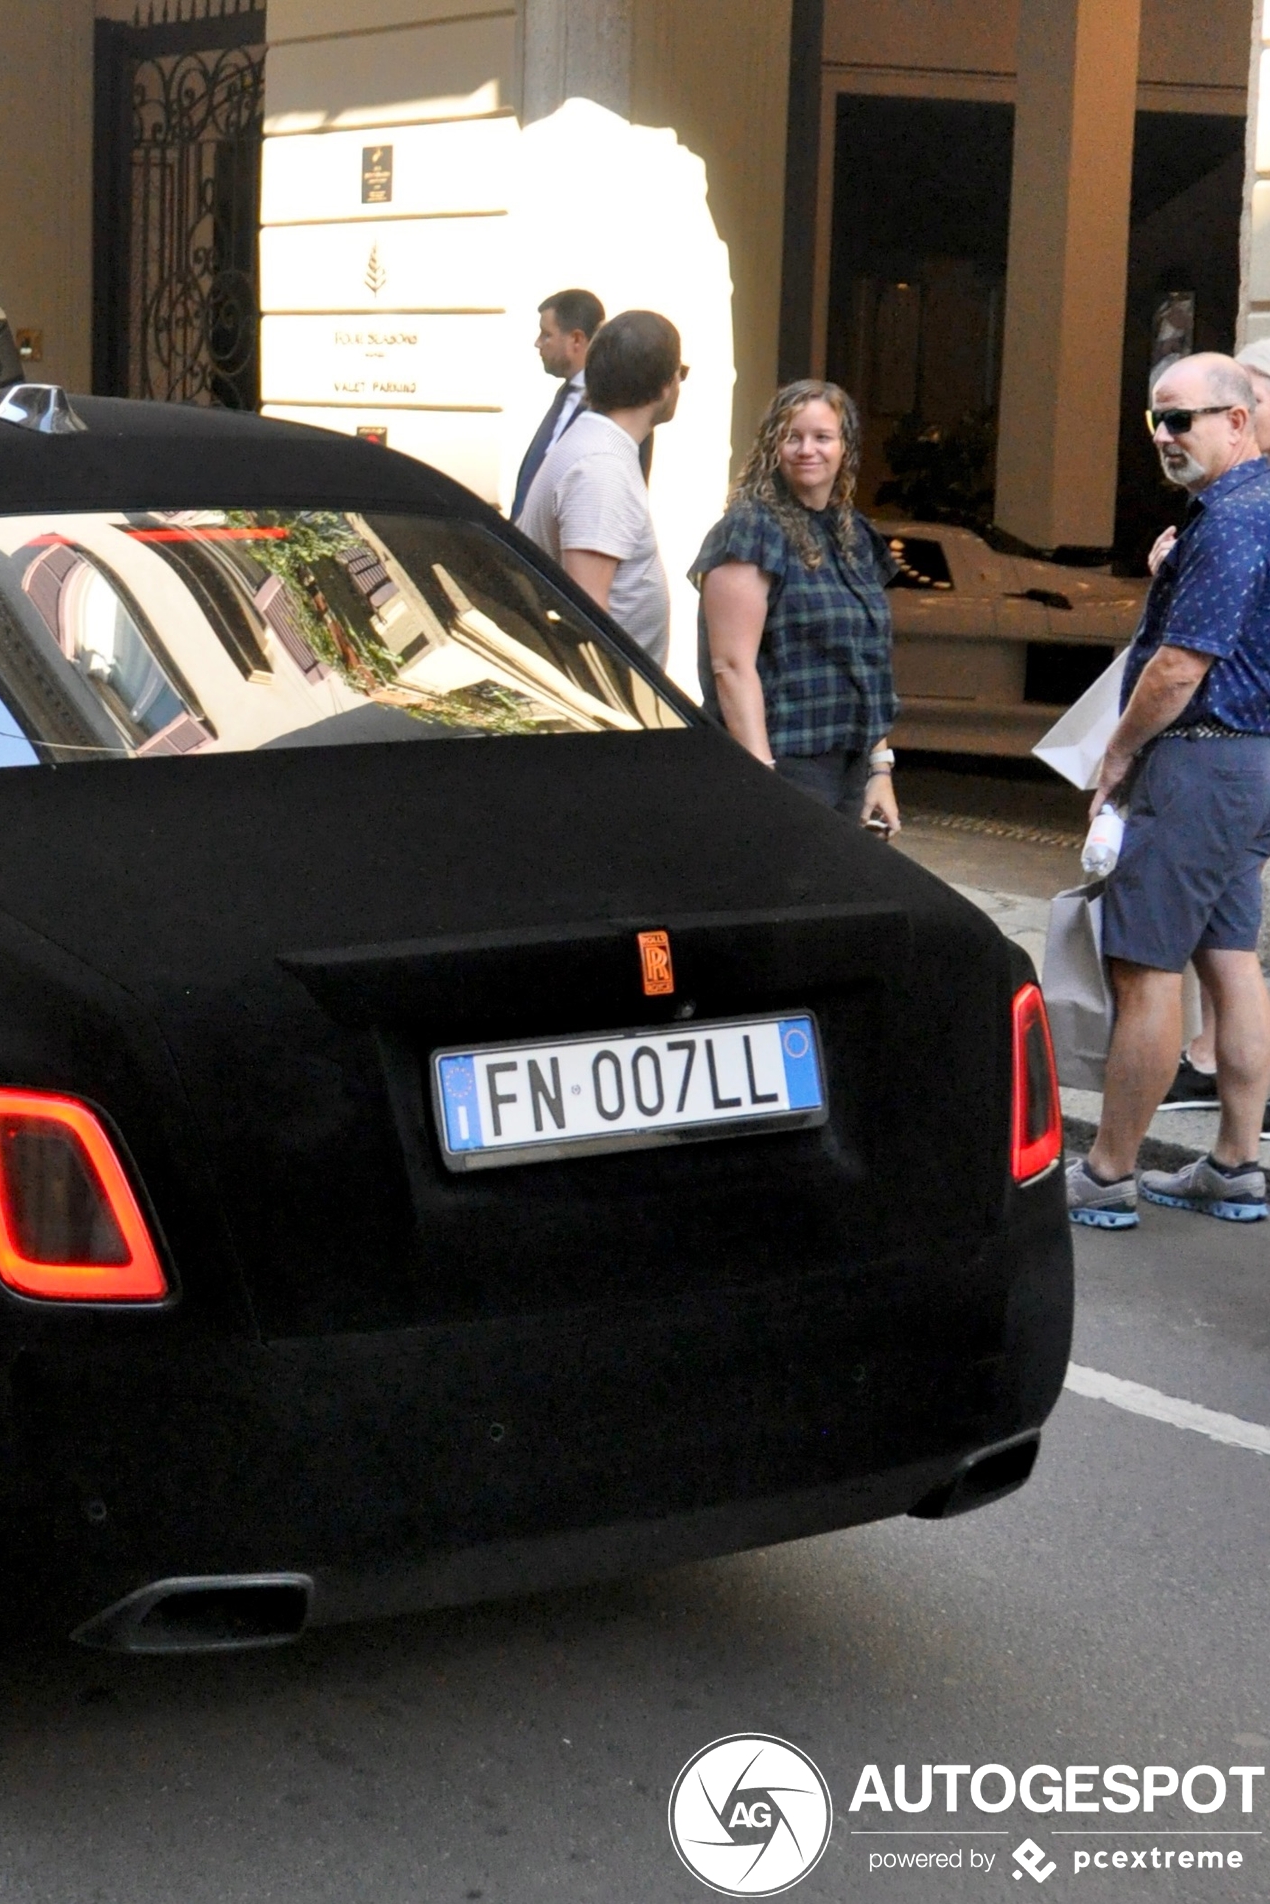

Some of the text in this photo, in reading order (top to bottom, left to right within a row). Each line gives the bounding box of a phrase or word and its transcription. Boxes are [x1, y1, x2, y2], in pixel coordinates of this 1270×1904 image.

[334, 382, 416, 394] VALET PARKING
[486, 1034, 779, 1137] FN 007LL
